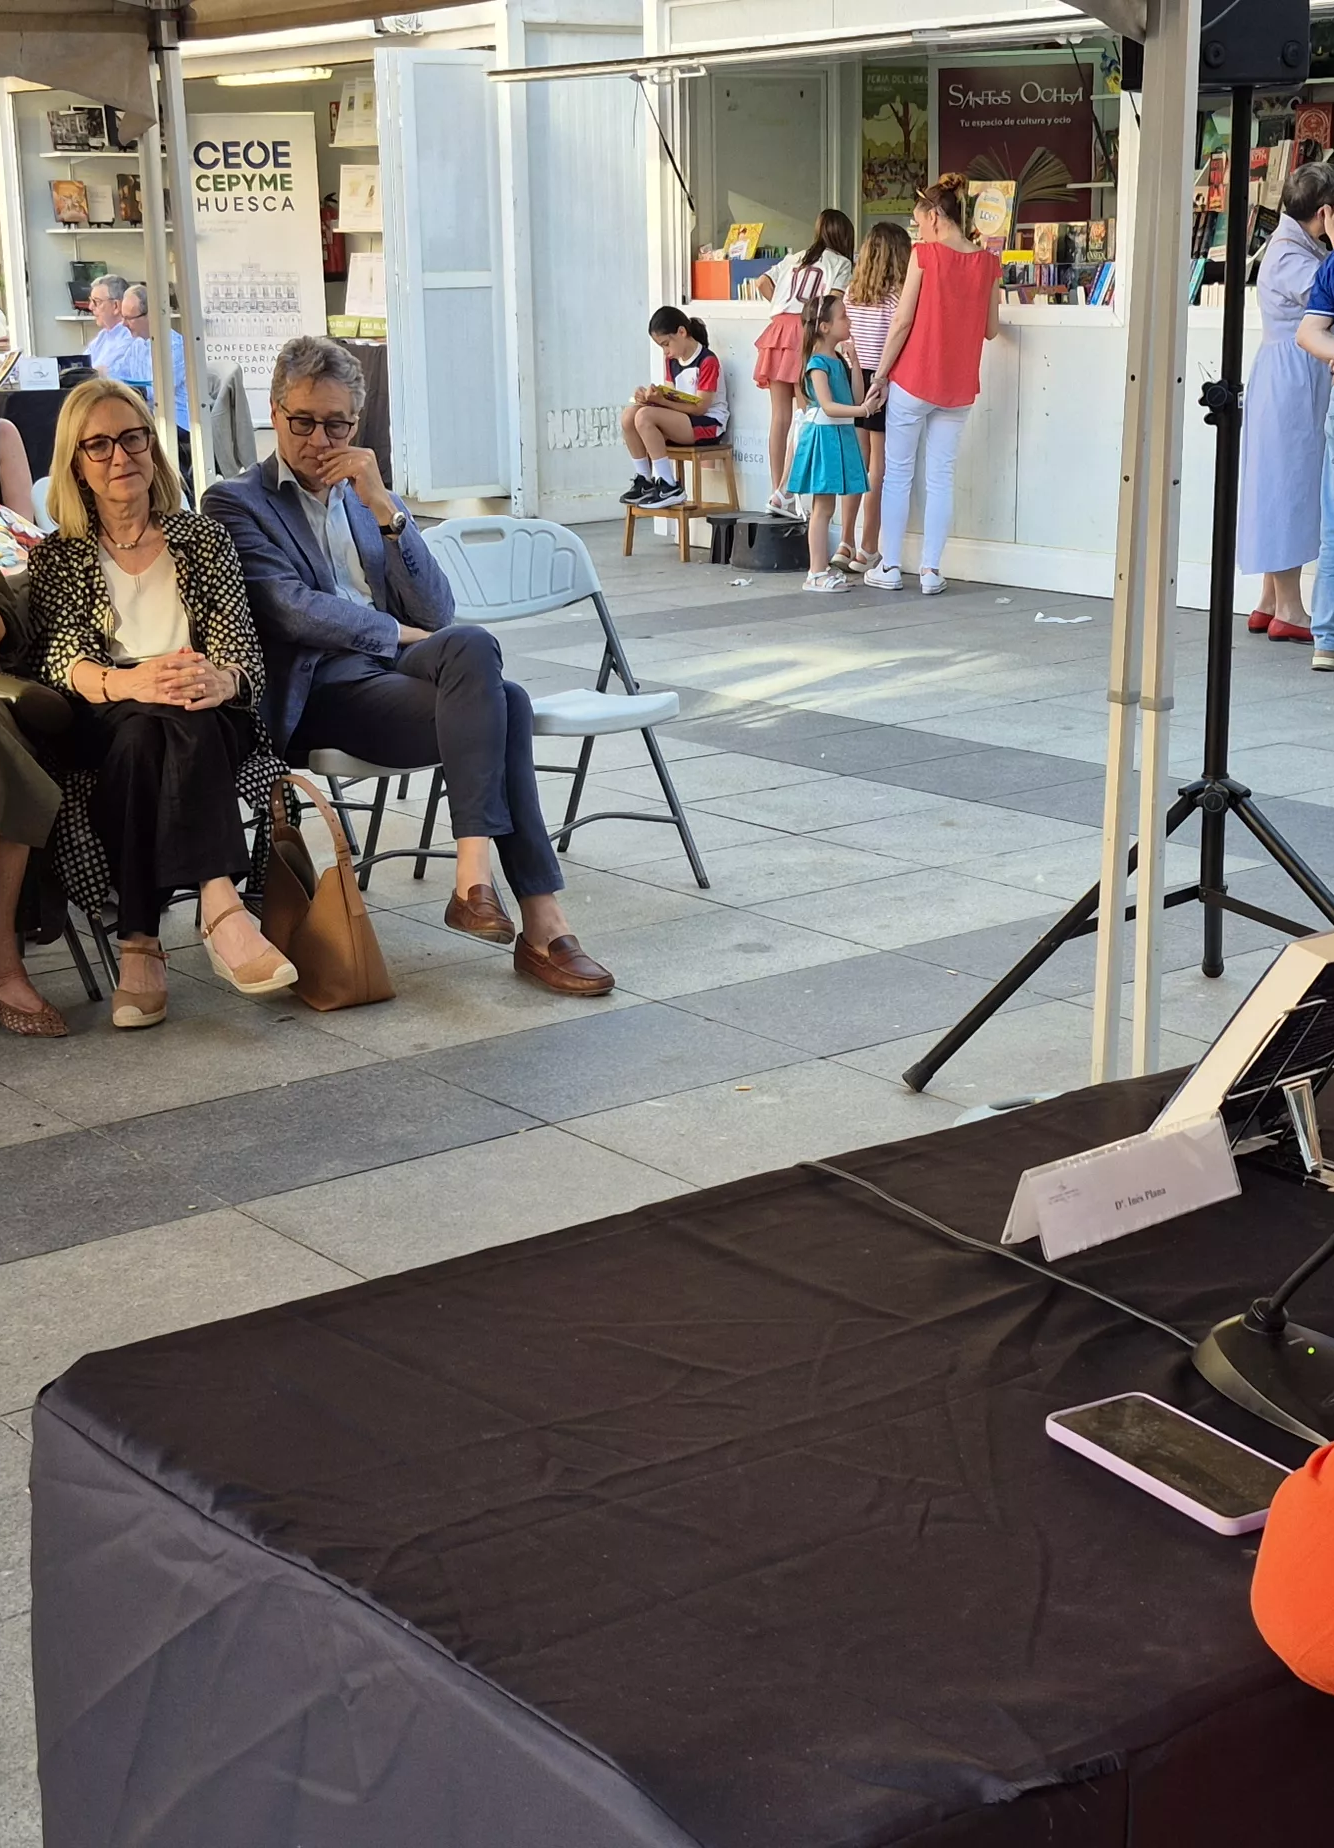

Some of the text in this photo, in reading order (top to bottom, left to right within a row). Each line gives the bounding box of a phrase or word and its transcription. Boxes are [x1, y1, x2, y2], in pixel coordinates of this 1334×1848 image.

[961, 119, 970, 127] Tu
[972, 118, 1003, 128] espacio
[1004, 117, 1015, 126] de
[1016, 116, 1046, 126] cultura
[1053, 116, 1072, 124] ocio
[193, 140, 292, 170] CEOE
[195, 173, 293, 192] CEPYME
[197, 195, 295, 213] HUESCA
[786, 265, 824, 303] 10
[207, 343, 282, 353] CONFEDERAC
[1127, 1194, 1144, 1207] Inés
[1145, 1186, 1167, 1200] Plana
